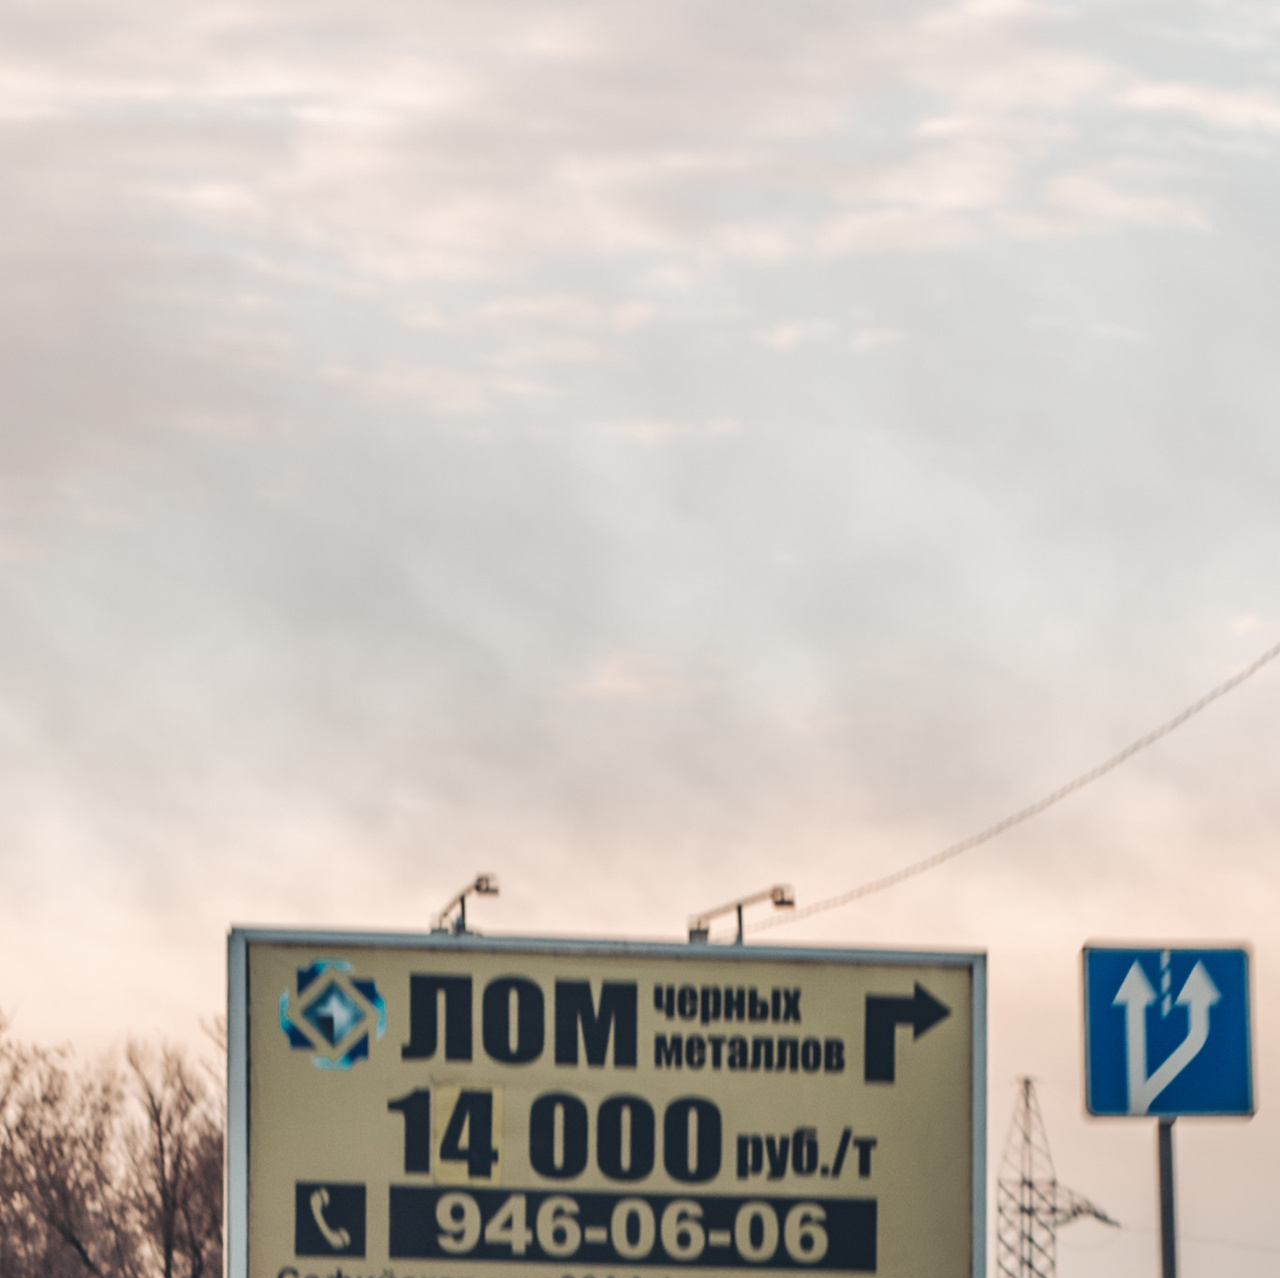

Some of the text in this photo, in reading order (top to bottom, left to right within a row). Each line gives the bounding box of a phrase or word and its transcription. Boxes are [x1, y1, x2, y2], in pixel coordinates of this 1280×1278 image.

[401, 973, 639, 1069] ЛОМ
[654, 983, 802, 1025] черных
[654, 1033, 846, 1073] металлов
[387, 1088, 877, 1184] 14 000 руб./т
[434, 1193, 829, 1264] 946-06-06
